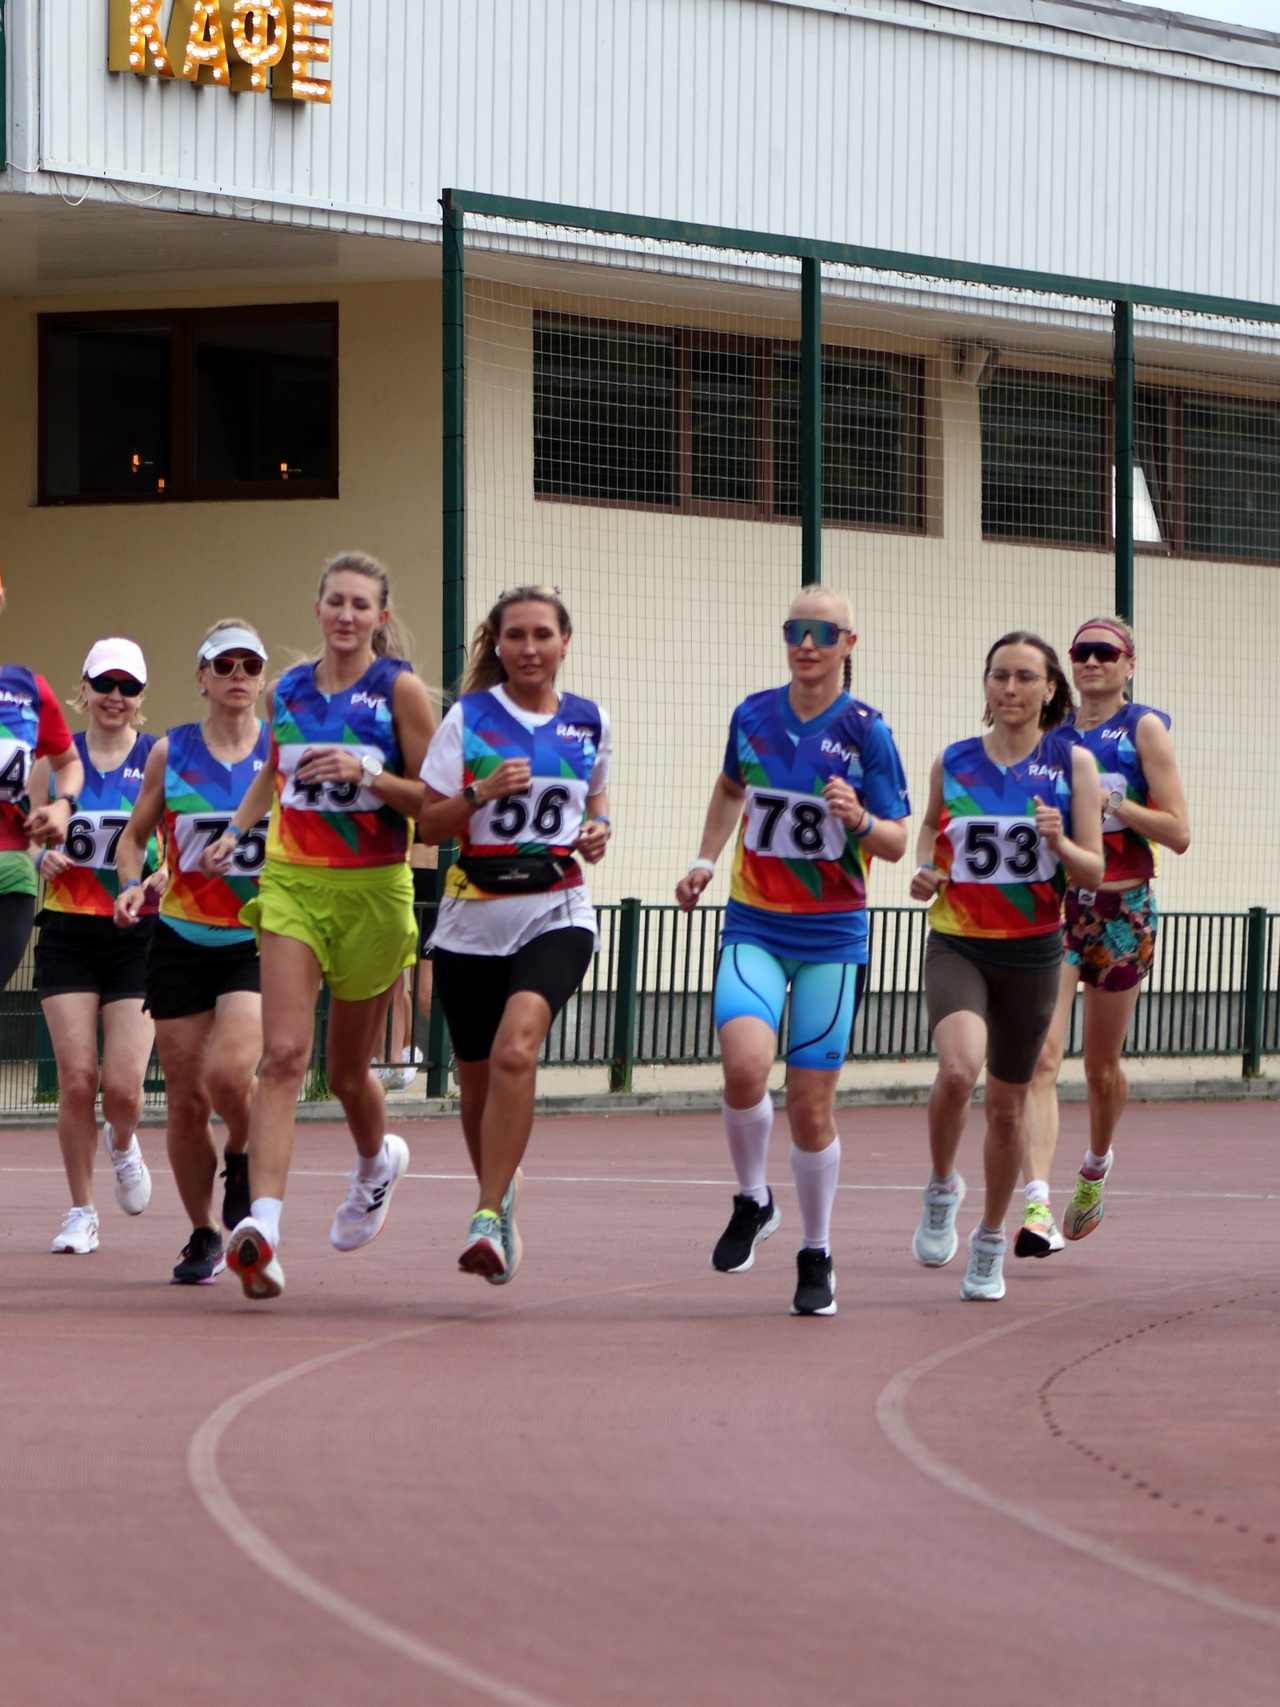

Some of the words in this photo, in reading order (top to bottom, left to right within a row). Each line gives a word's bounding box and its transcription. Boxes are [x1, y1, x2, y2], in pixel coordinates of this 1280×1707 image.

[128, 0, 333, 104] КАФЕ
[820, 739, 860, 764] RAVE
[64, 815, 131, 867] 67
[489, 784, 571, 841] 56
[753, 792, 827, 856] 78
[193, 816, 272, 873] 75
[964, 821, 1041, 879] 53
